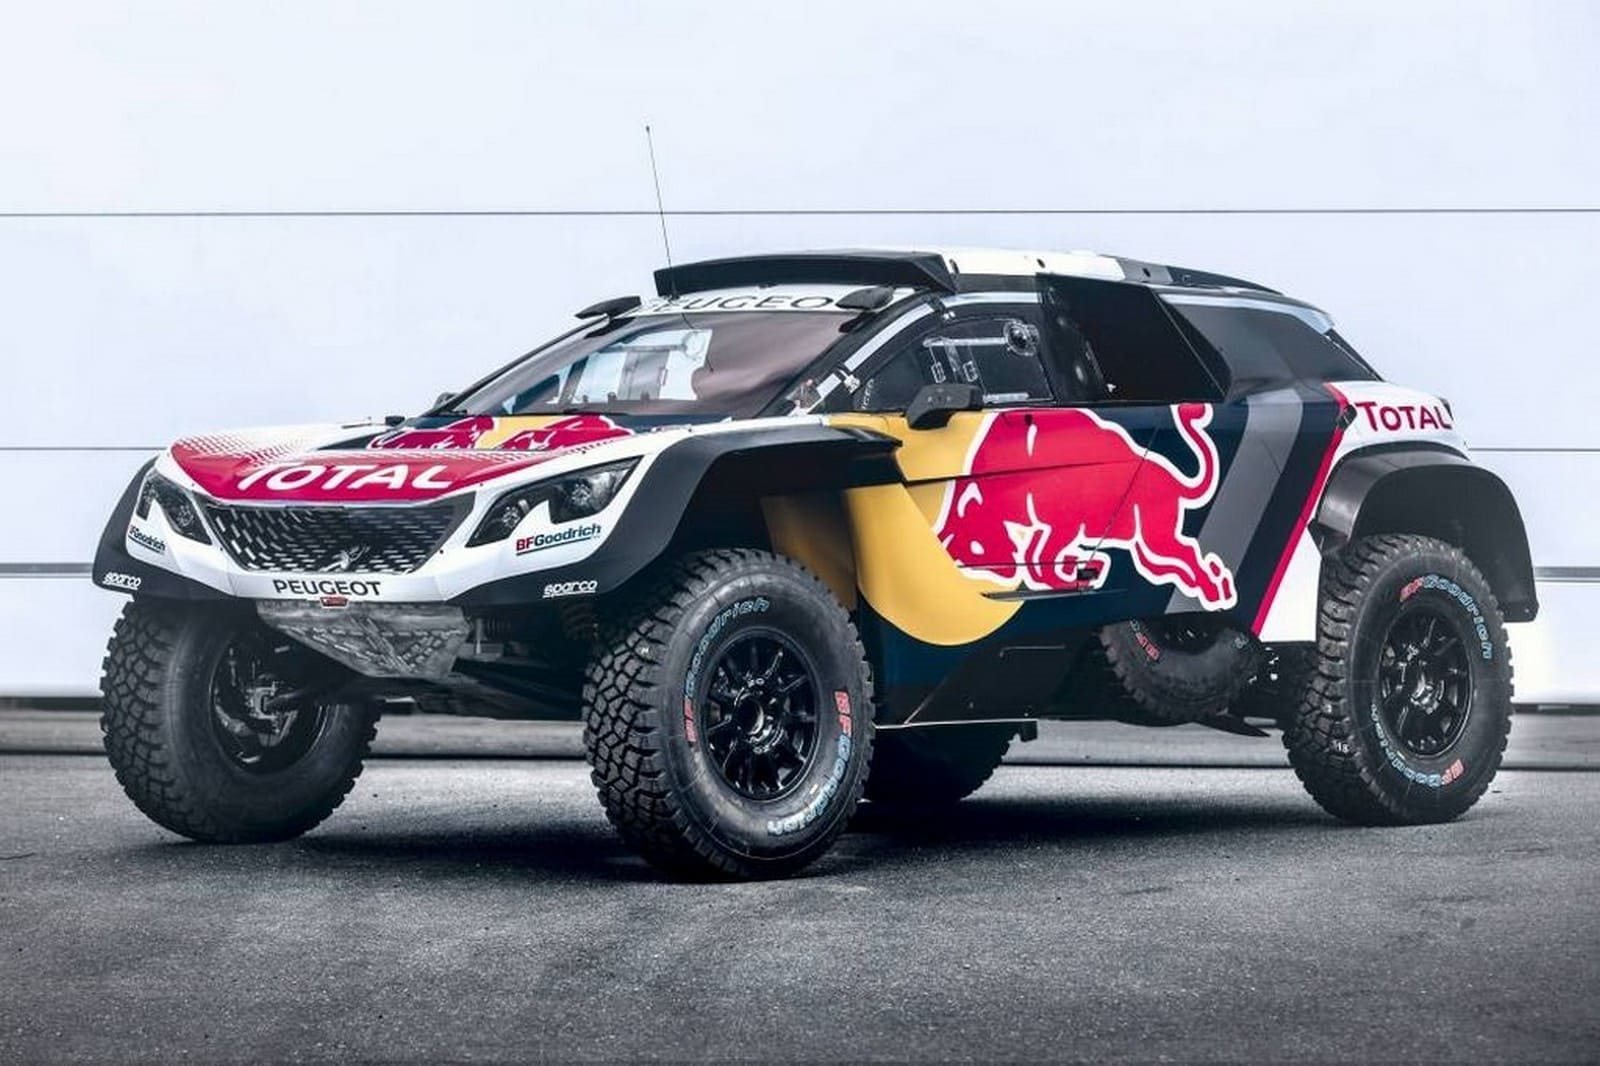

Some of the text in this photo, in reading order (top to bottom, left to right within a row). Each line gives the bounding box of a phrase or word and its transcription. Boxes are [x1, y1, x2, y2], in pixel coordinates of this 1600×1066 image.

[1355, 401, 1452, 431] TOTAL
[237, 463, 453, 492] TOTAL
[516, 524, 601, 551] BFGoodrich
[274, 580, 381, 596] PEUGEOT
[543, 581, 597, 598] sparco
